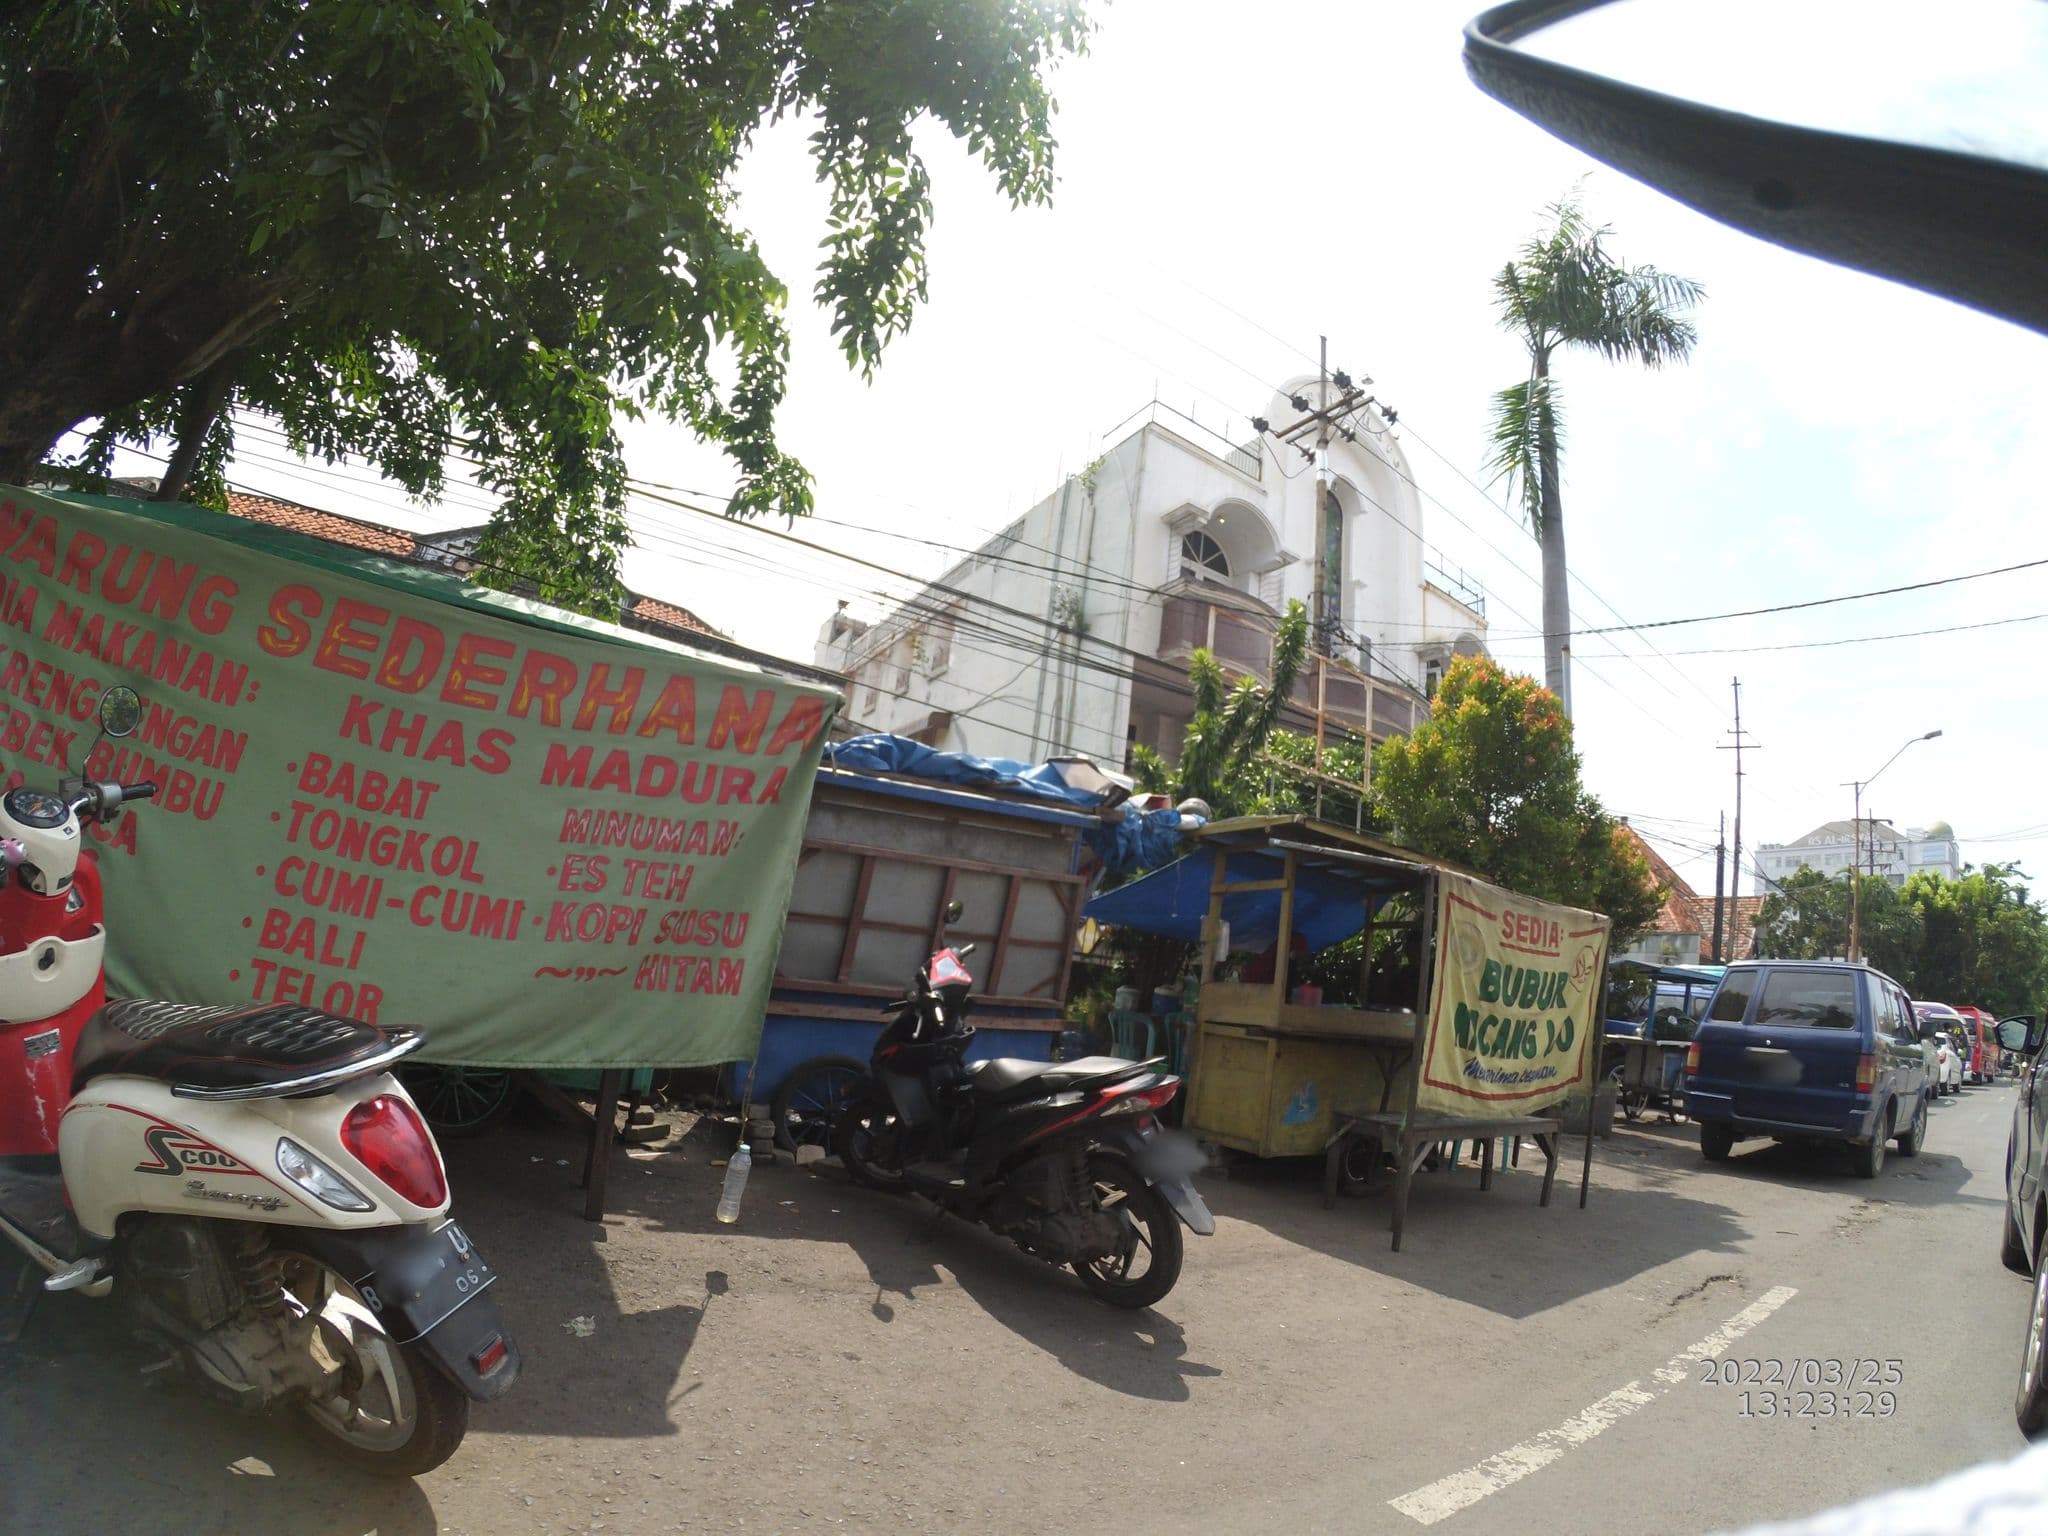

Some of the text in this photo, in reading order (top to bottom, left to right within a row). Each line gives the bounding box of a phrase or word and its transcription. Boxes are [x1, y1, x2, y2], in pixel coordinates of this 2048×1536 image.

[43, 599, 260, 707] MAKANAN:
[257, 584, 829, 757] SEDERHANA
[339, 694, 790, 806] KHAS MADURA
[298, 752, 440, 820] BABAT
[286, 800, 485, 884] TONGKOL
[274, 855, 525, 942] CUMI-CUMI
[559, 854, 695, 902] ES TEH
[258, 908, 368, 971] BALI
[544, 900, 750, 949] KOPI SUSU
[251, 957, 384, 1025] TELOR
[633, 953, 745, 996] HITAM
[1479, 958, 1569, 1011] BUBUR
